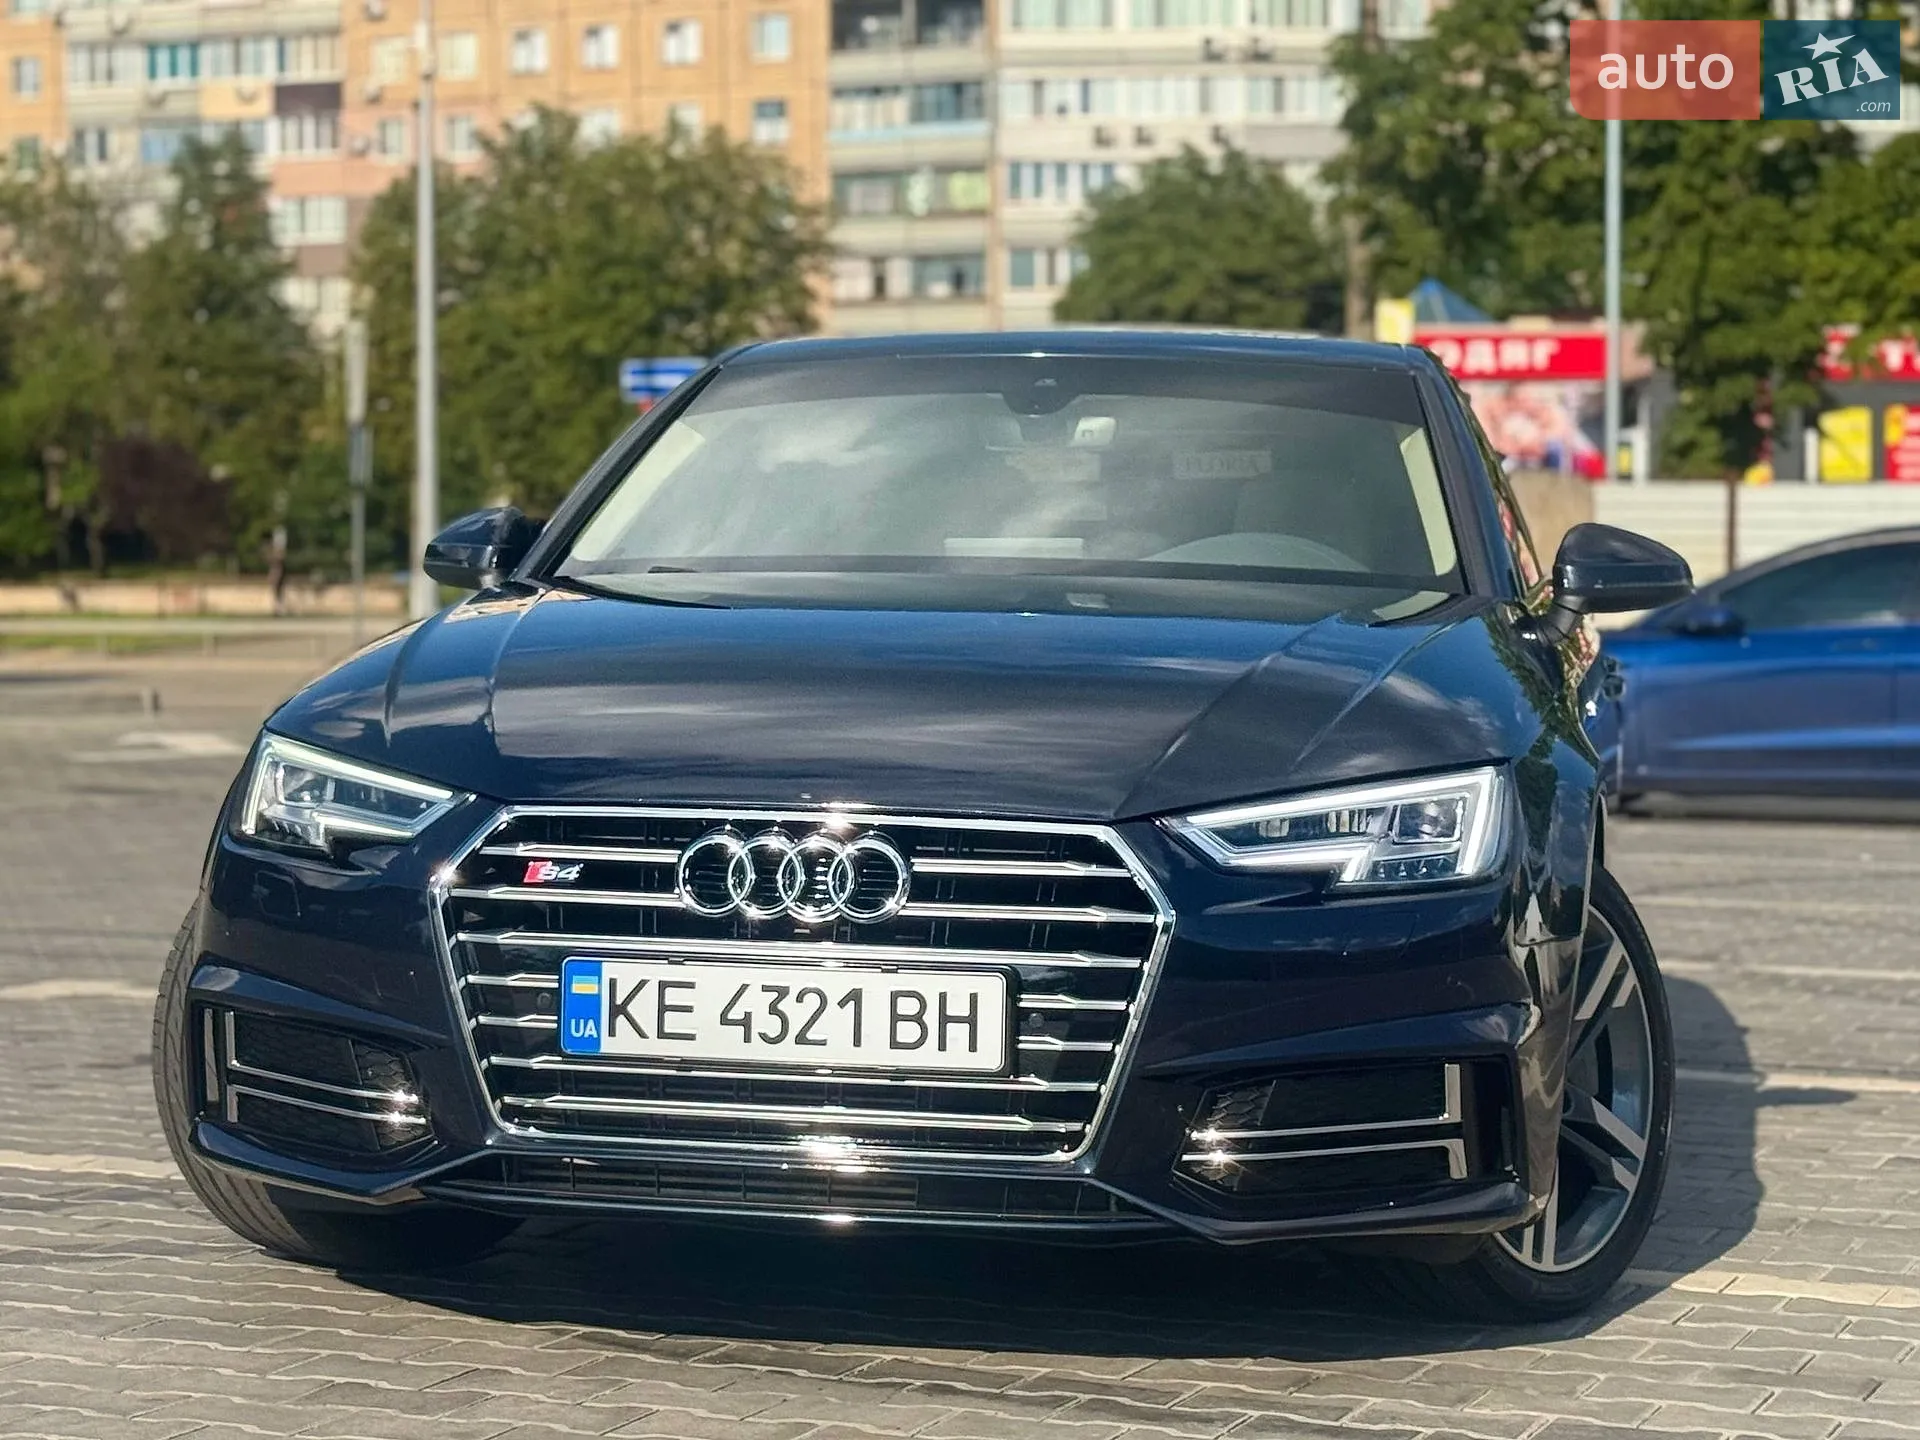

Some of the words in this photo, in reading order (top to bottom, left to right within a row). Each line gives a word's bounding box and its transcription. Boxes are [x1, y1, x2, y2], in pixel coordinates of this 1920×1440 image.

[570, 1018, 598, 1038] UA
[608, 977, 697, 1040] KE
[719, 983, 863, 1047] 4321
[889, 989, 978, 1052] BH
